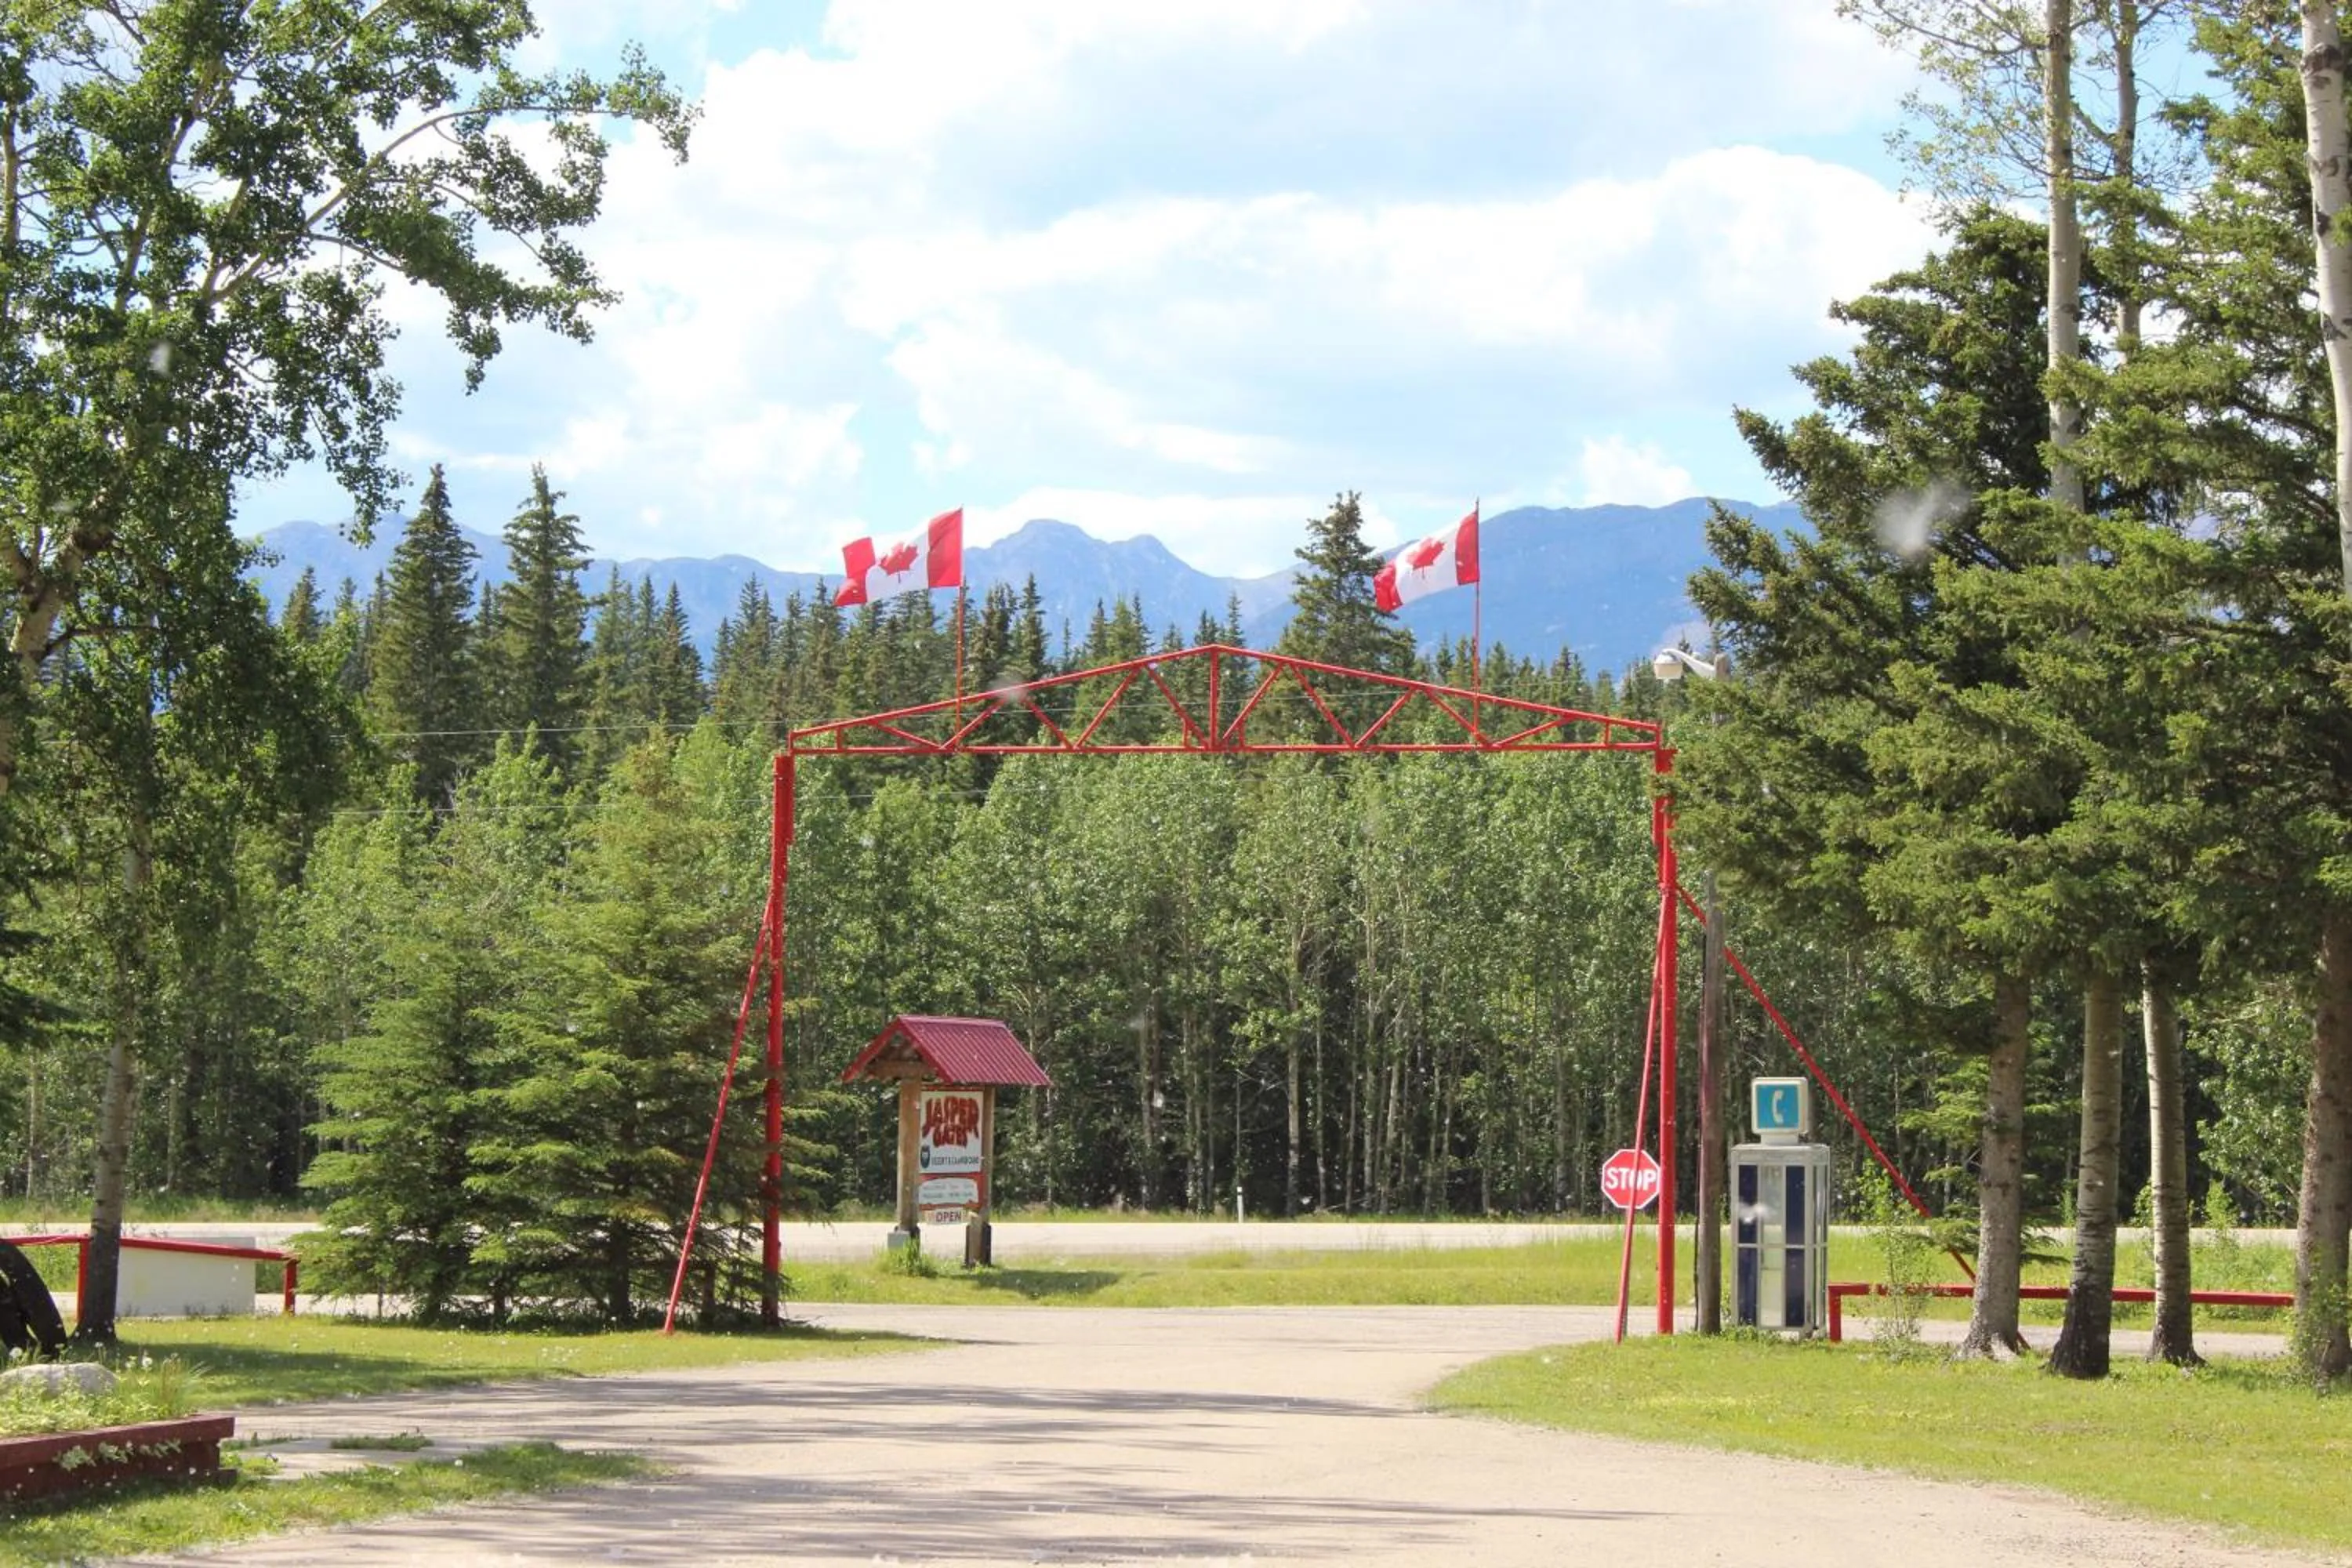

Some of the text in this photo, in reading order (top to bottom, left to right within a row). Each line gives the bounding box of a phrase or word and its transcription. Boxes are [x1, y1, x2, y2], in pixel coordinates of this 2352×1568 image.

[922, 1096, 979, 1138] JASPER
[1605, 1167, 1657, 1191] STOP
[936, 1210, 961, 1222] OPEN
